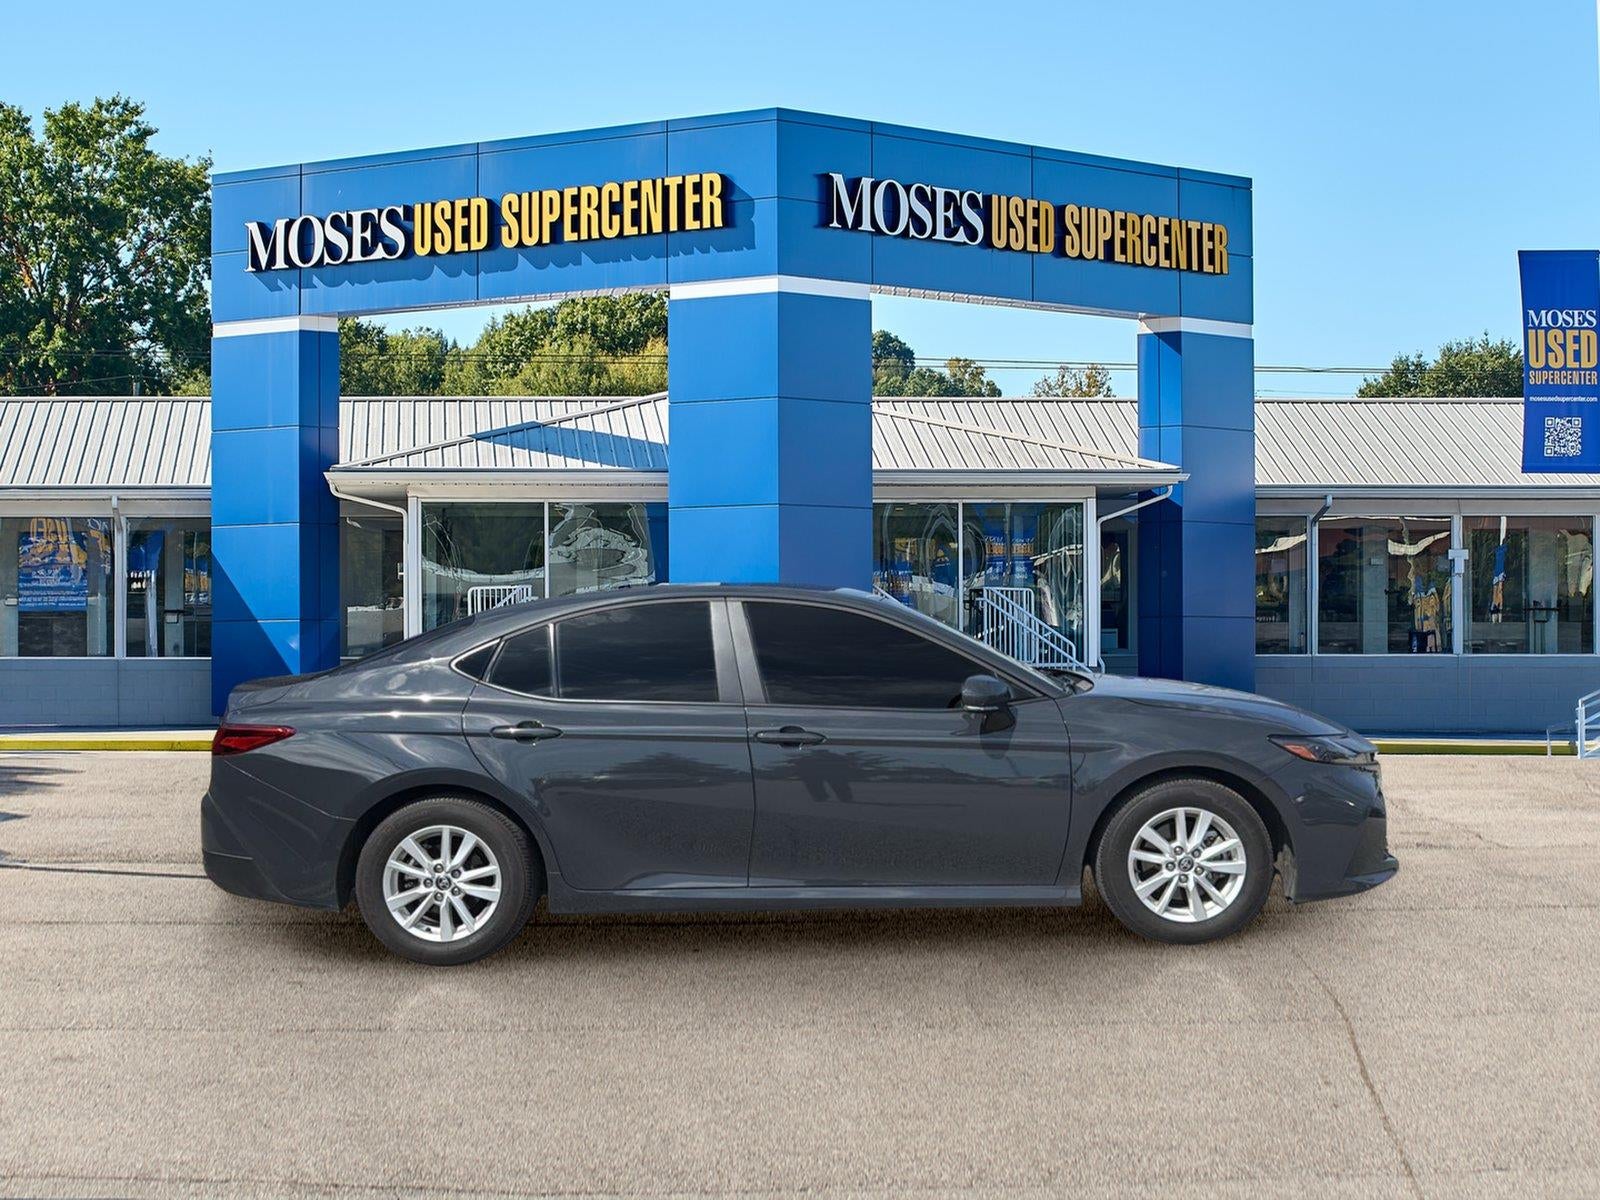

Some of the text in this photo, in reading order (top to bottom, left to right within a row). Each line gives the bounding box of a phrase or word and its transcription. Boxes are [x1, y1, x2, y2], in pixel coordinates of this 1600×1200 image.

[245, 172, 724, 273] MOSES USED SUPERCENTER
[828, 172, 1230, 276] MOSES USED SUPERCENTER
[1528, 309, 1597, 328] MOSES
[1528, 329, 1598, 369] USED
[1529, 370, 1598, 385] SUPERCENTER
